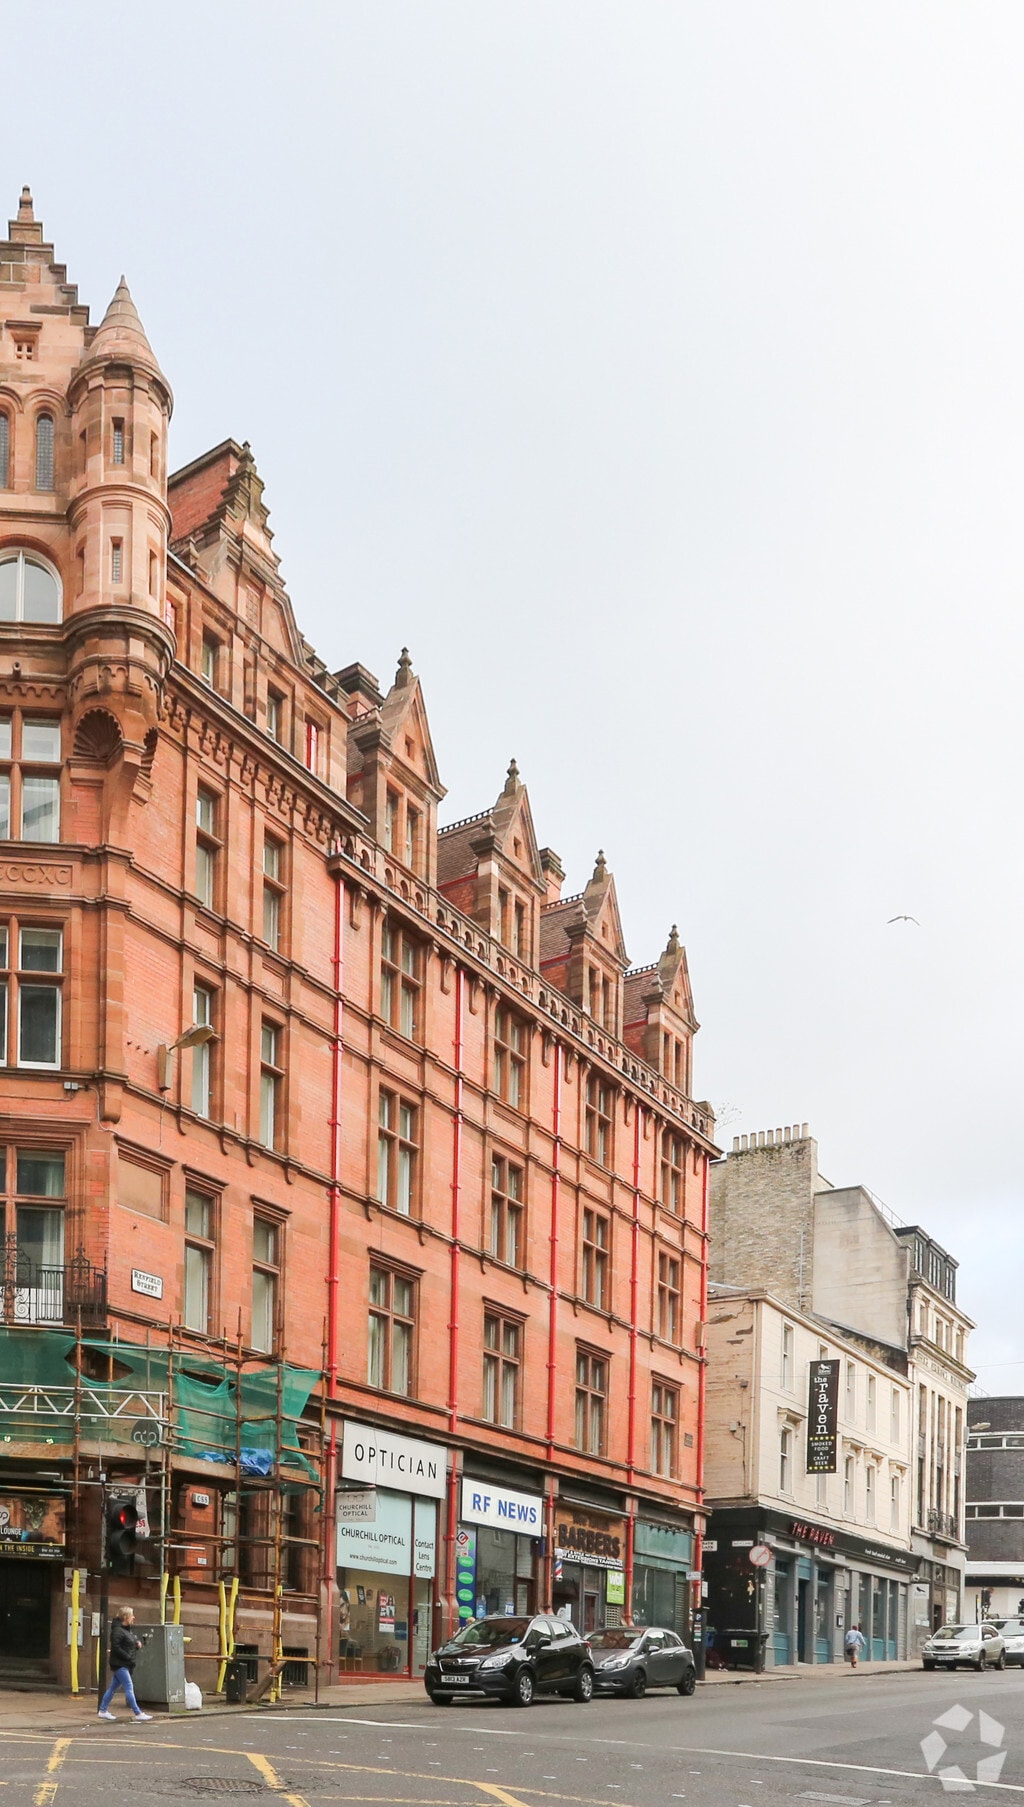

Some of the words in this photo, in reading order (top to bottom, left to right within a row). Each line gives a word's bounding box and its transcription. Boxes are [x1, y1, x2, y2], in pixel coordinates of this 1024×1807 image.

[134, 1270, 161, 1286] RENFIELD
[136, 1280, 158, 1292] STREET
[354, 1443, 437, 1479] OPTICIAN
[472, 1493, 491, 1513] RF
[498, 1500, 537, 1524] NEWS
[0, 1526, 22, 1536] LOUNGE
[341, 1527, 378, 1542] CHURCHILL
[378, 1533, 405, 1547] OPTICAL
[792, 1522, 807, 1538] THE
[808, 1528, 835, 1545] RAVEN
[414, 1539, 434, 1550] Contact
[558, 1523, 620, 1560] BARBERS
[16, 1545, 35, 1553] INSIDE
[418, 1552, 430, 1561] Lens
[416, 1562, 433, 1572] Centre
